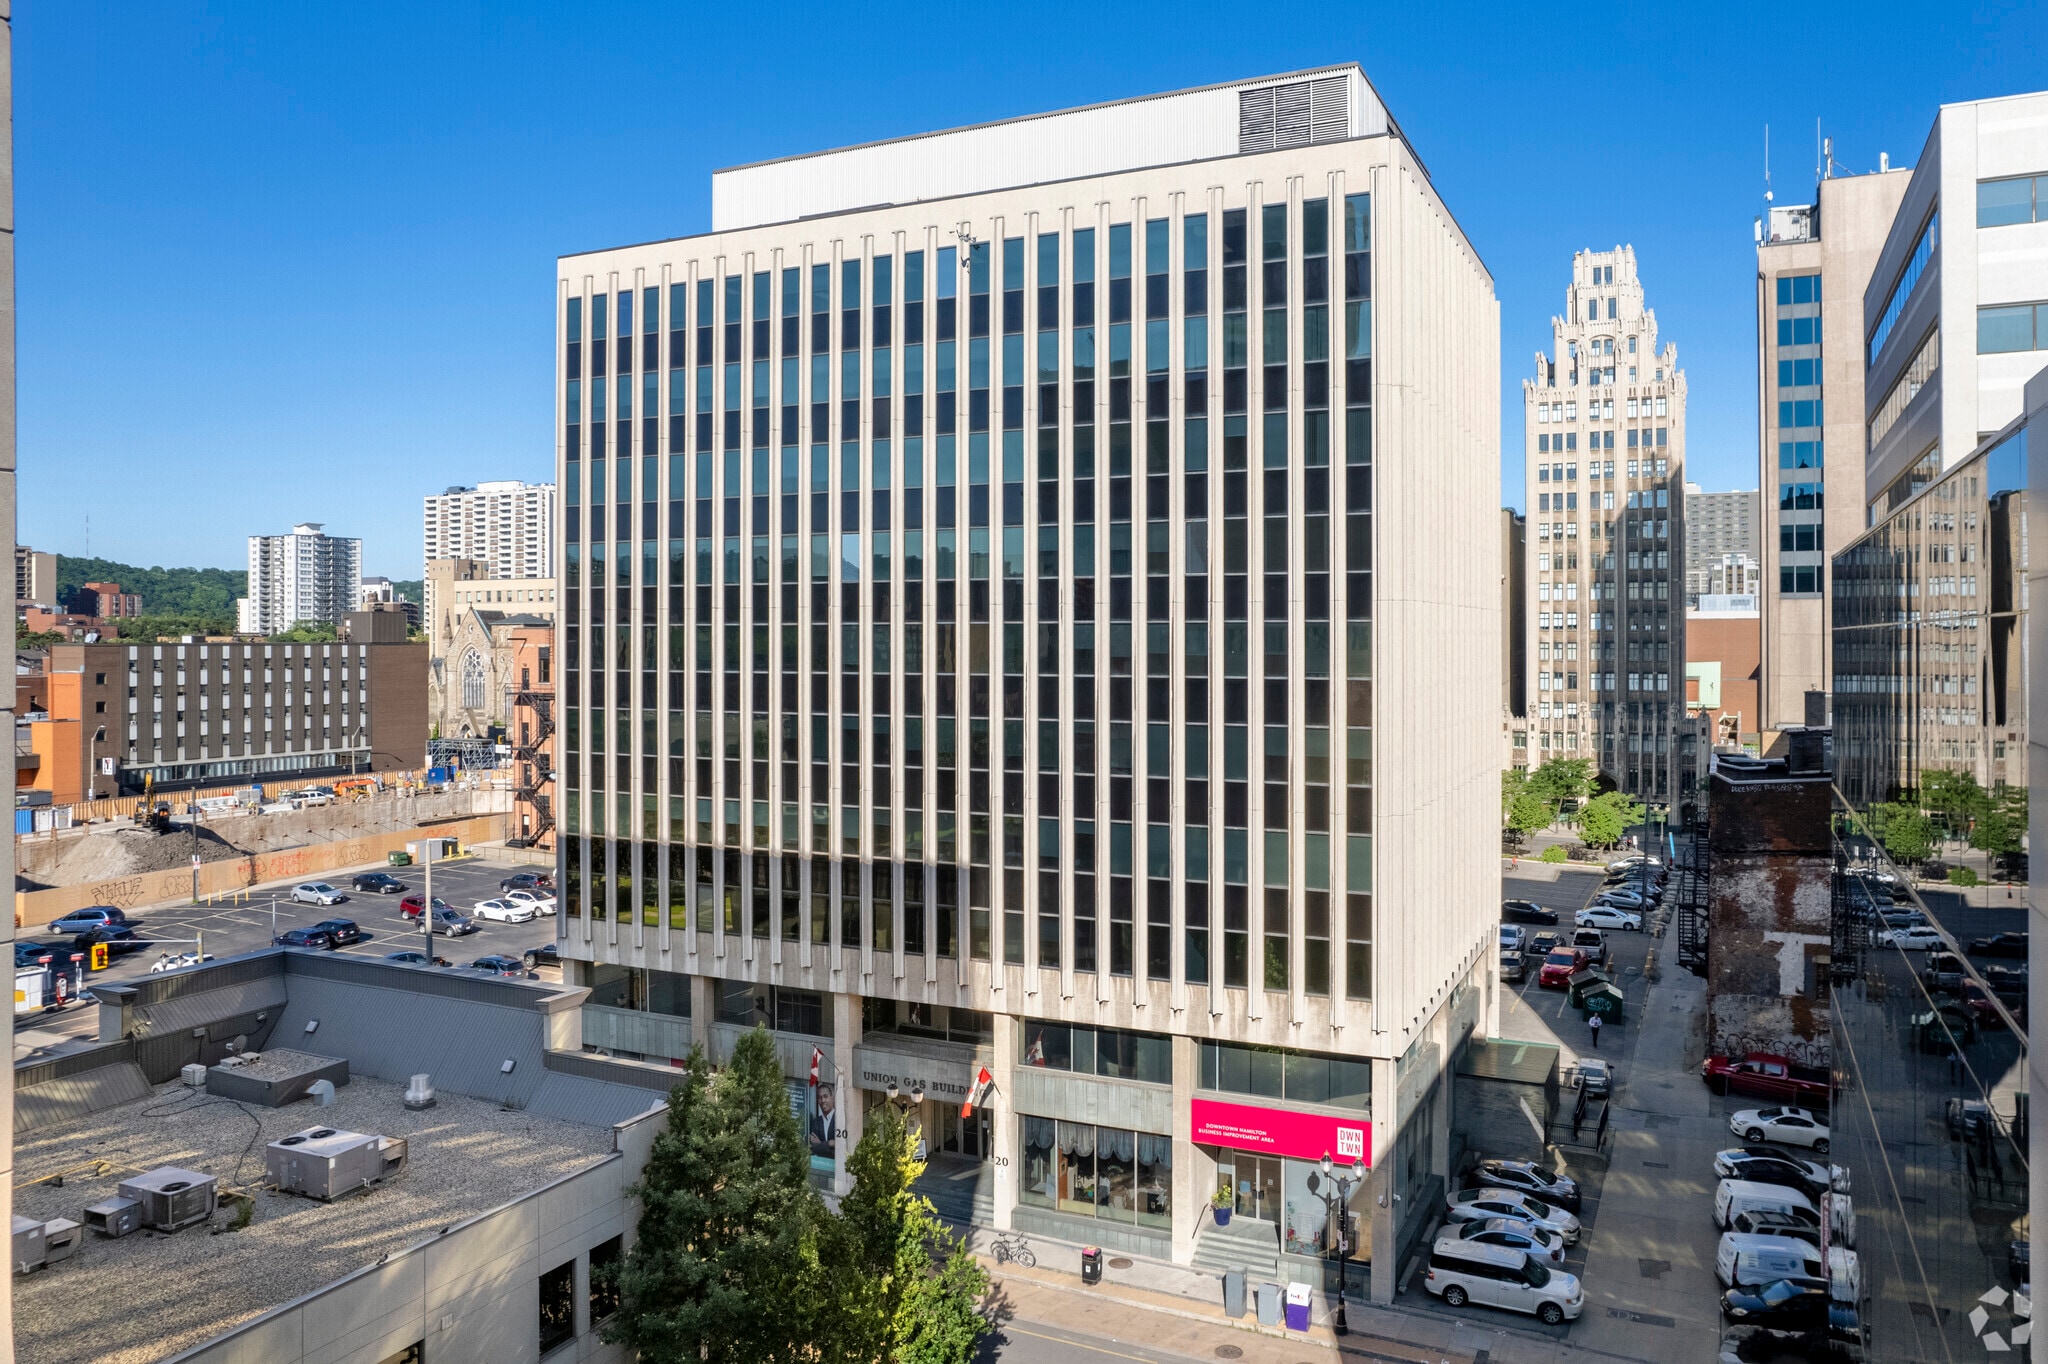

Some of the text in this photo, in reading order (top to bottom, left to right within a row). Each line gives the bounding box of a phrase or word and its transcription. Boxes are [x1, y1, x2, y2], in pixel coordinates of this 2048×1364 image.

[863, 1071, 987, 1098] UNION GAS BUILDIG
[836, 1128, 848, 1139] 20
[1198, 1127, 1222, 1136] BUSINESS
[1223, 1131, 1260, 1141] IMPROVEMENT
[1206, 1123, 1267, 1136] DOWNTOWN HAMILTON
[1340, 1130, 1360, 1143] DWN
[1340, 1142, 1360, 1154] TWN
[995, 1156, 1009, 1167] 20
